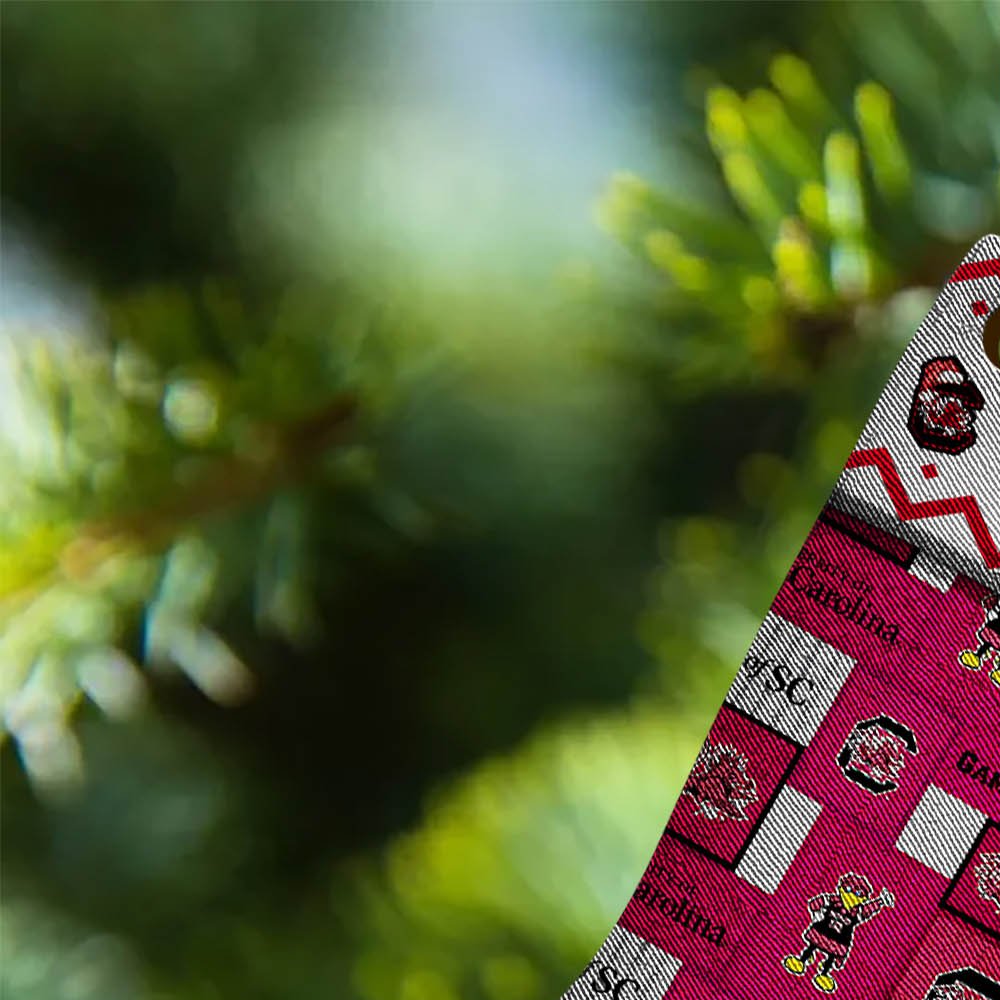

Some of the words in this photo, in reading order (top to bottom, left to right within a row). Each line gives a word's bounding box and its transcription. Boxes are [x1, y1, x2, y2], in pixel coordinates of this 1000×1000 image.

[791, 565, 901, 646] Carolina
[744, 656, 814, 706] ofSC
[637, 881, 727, 947] arolina
